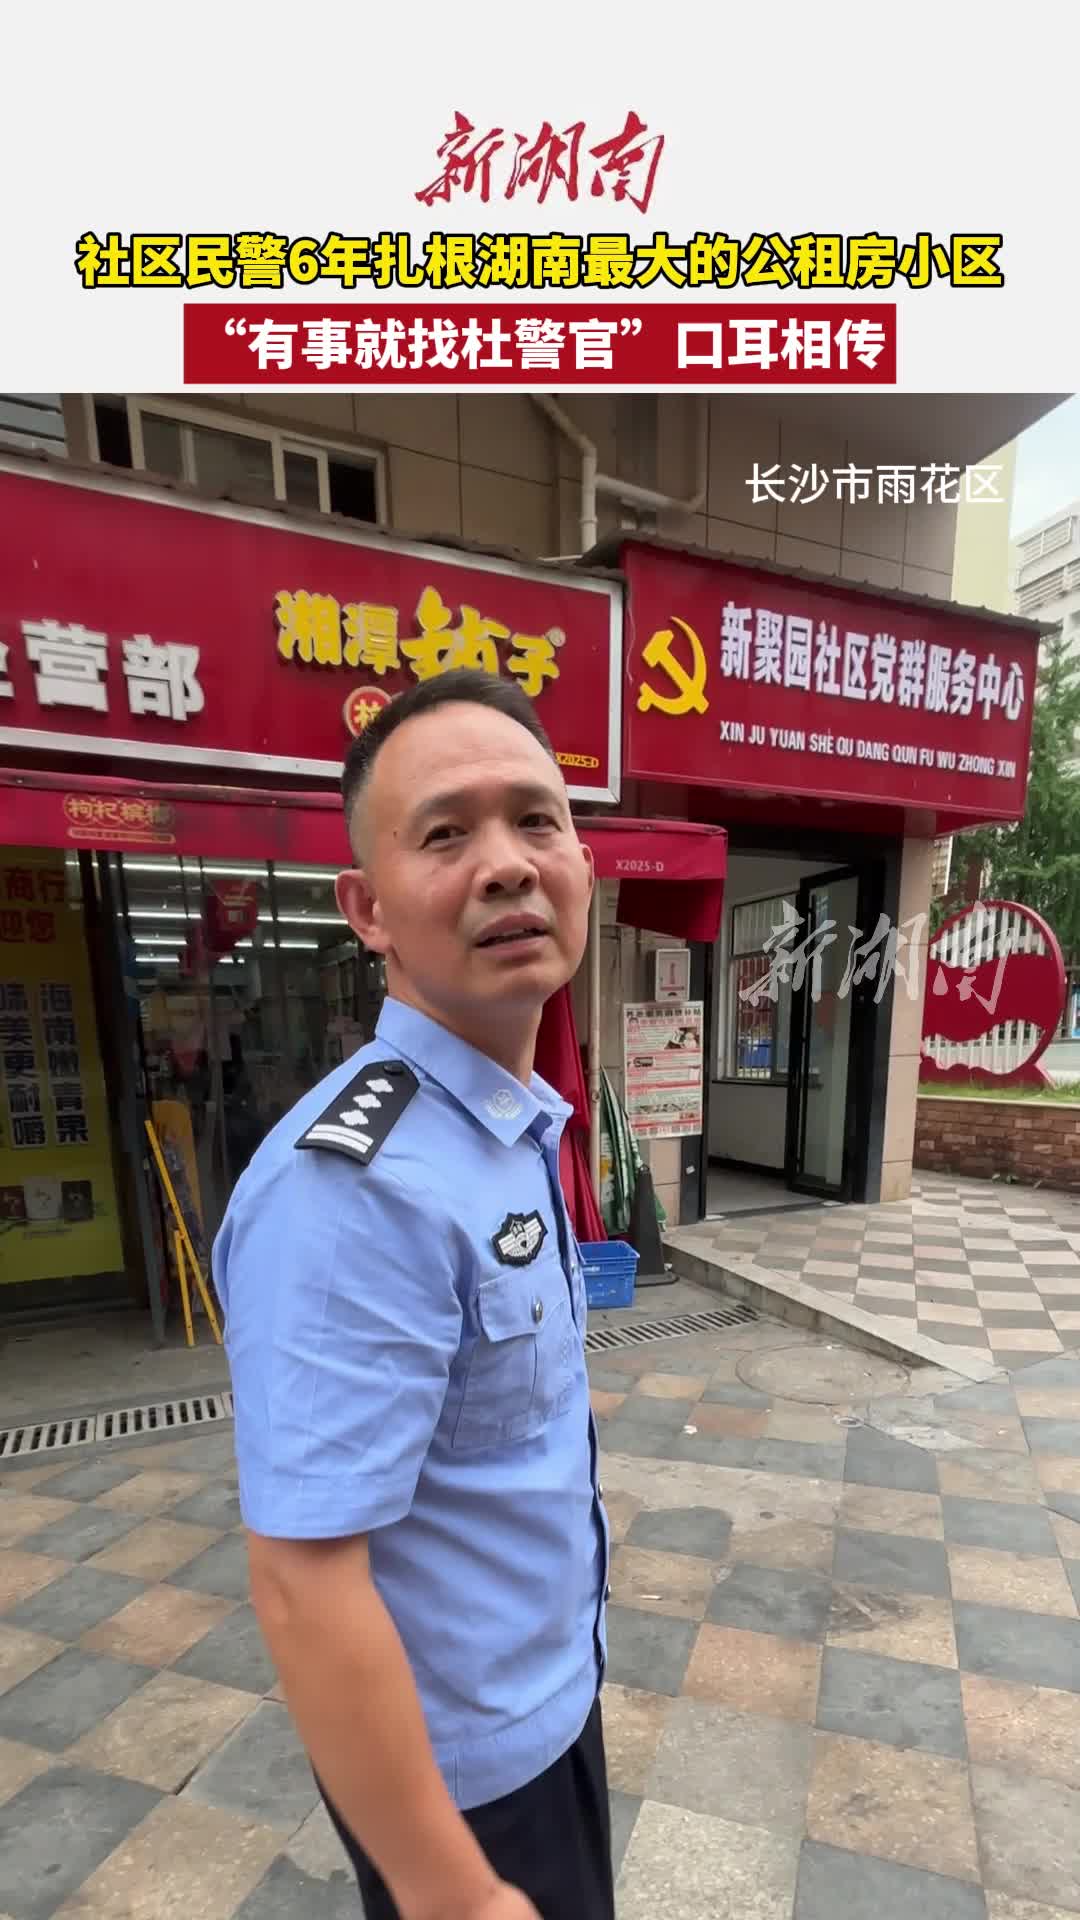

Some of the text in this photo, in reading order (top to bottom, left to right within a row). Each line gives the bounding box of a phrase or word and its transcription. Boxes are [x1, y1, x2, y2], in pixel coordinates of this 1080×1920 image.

[720, 601, 1024, 720] 新聚园社区党群服务中心
[719, 720, 745, 742] XIN
[748, 725, 766, 745] JU
[769, 727, 806, 751] YUAN
[809, 733, 834, 754] SHE
[856, 740, 890, 762] DANG
[892, 744, 917, 765] QUN
[919, 748, 934, 767] FU
[937, 751, 956, 769] WU
[957, 754, 995, 776] ZHONG
[997, 759, 1016, 778] XIN
[615, 859, 665, 872] X2025-D
